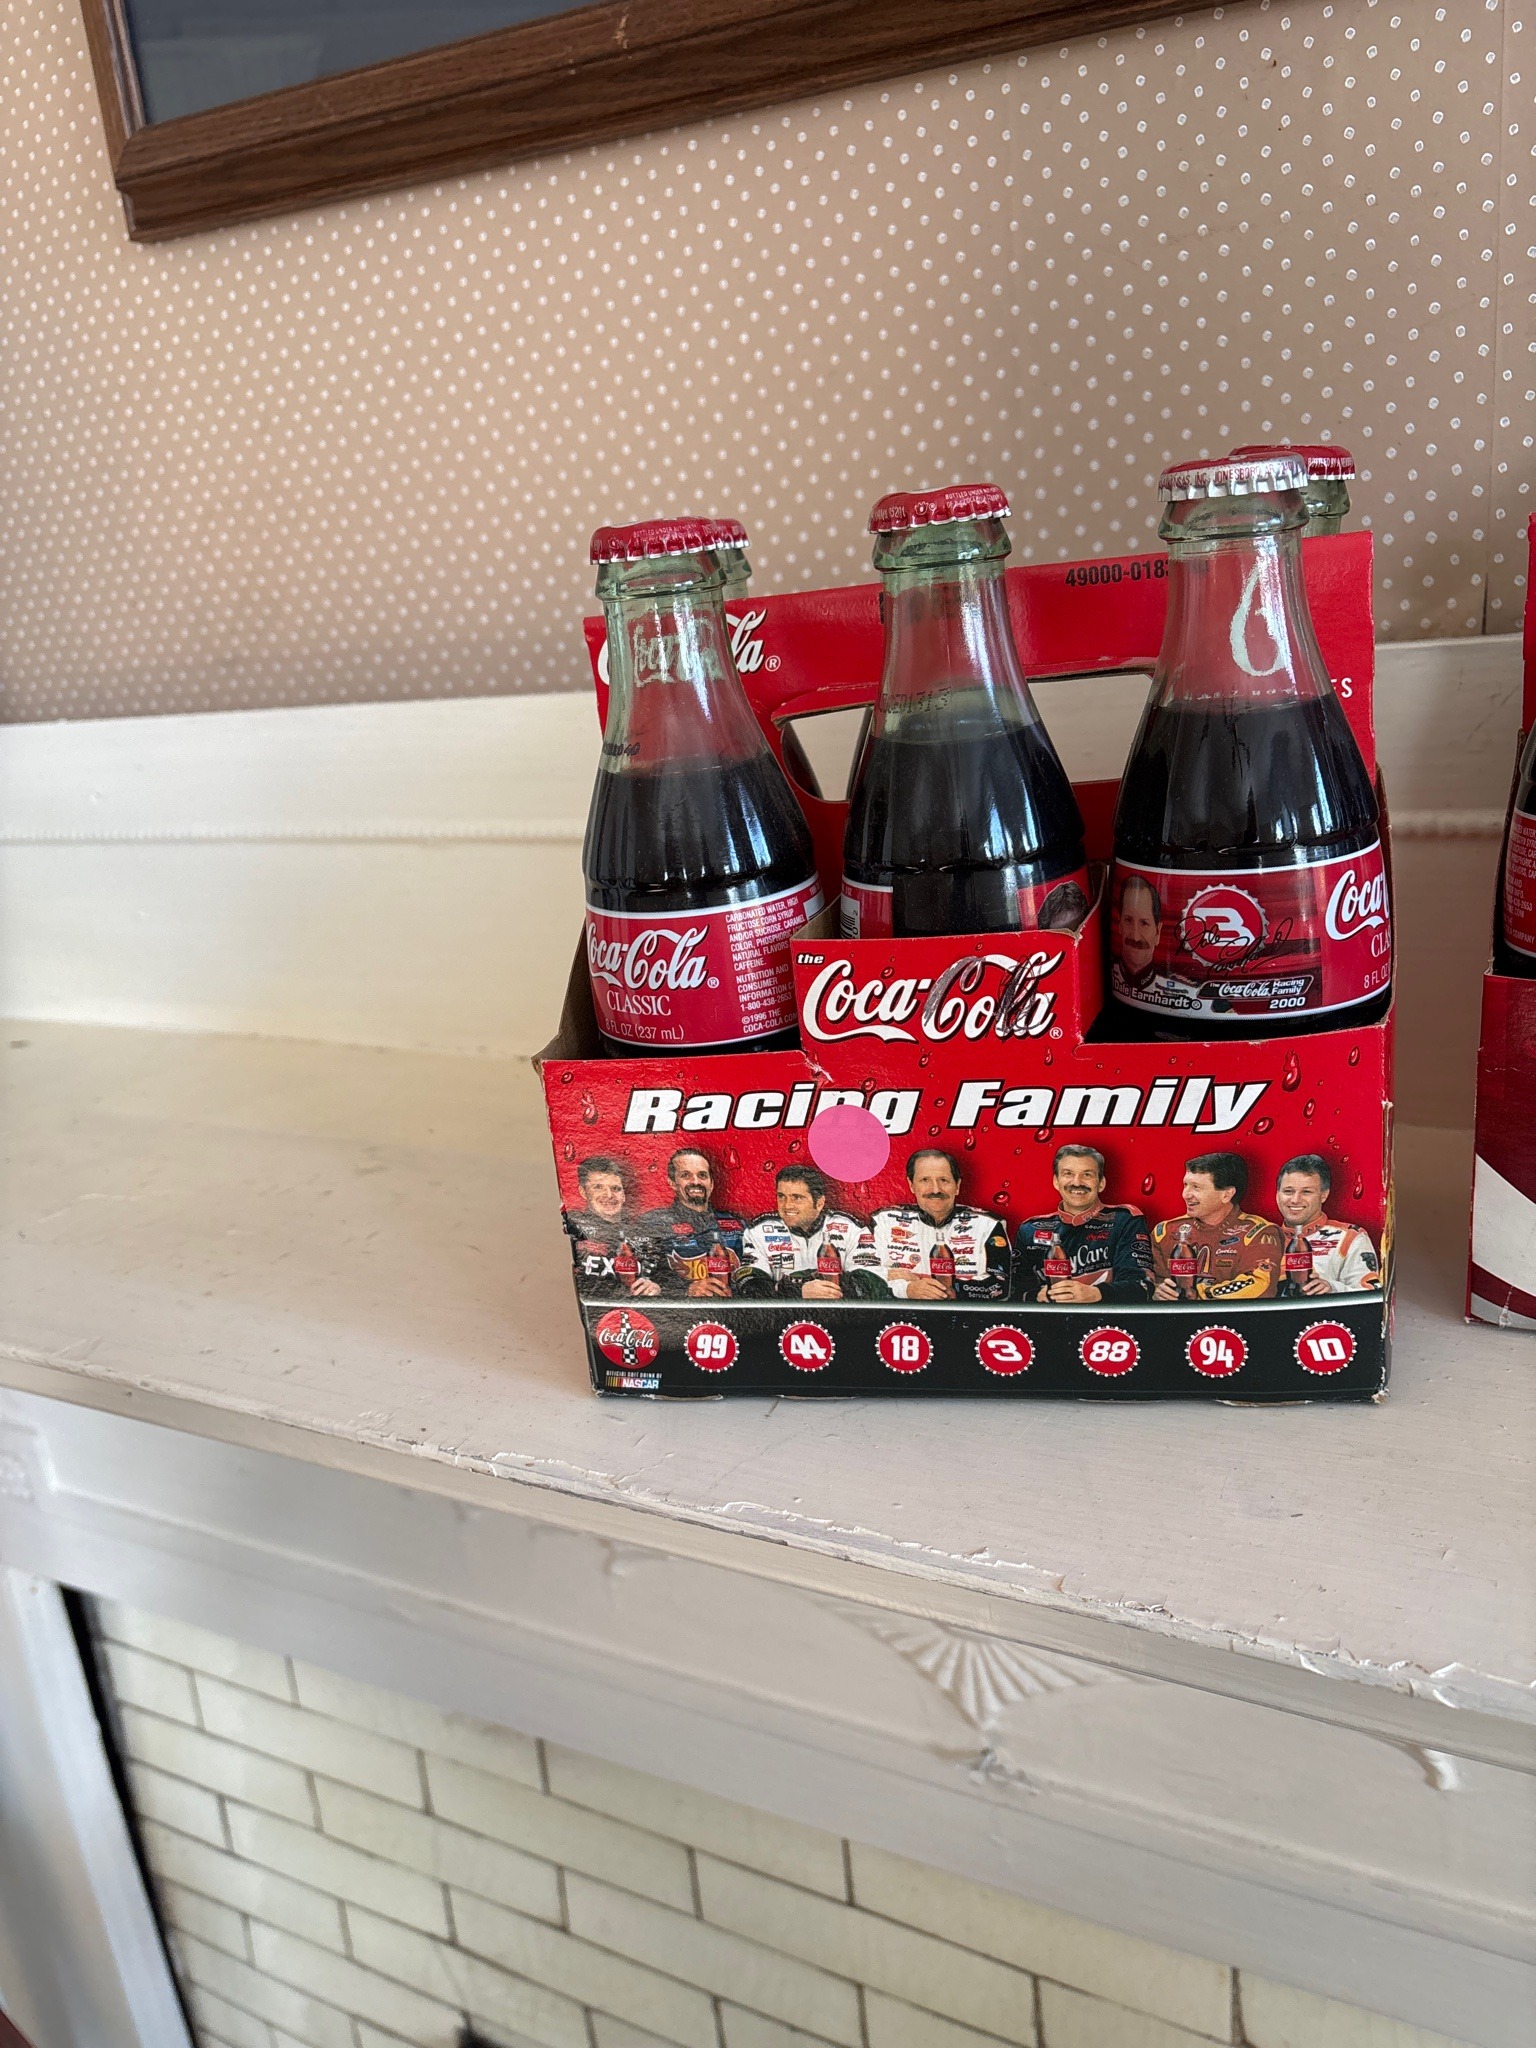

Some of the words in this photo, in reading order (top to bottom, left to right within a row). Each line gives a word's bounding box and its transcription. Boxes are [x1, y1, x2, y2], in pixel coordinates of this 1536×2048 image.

[725, 908, 766, 923] CARBONATED
[766, 901, 787, 916] WATER,
[787, 896, 799, 907] HIGH
[727, 919, 760, 933] FRUCTOSE
[761, 914, 777, 926] CORN
[777, 908, 794, 920] SYRUP
[729, 930, 754, 942] AND/OR
[783, 914, 806, 929] CARAMEL
[730, 941, 755, 952] COLOR,
[756, 931, 793, 947] PHOSPHORIC
[586, 923, 709, 990] Coca-Cola
[732, 949, 762, 962] NATURAL
[734, 958, 767, 971] CAFFEINE.
[797, 953, 824, 964] the
[736, 967, 774, 984] NUTRITION
[775, 964, 789, 974] AND
[1272, 978, 1305, 988] Racing
[1363, 974, 1370, 989] 8
[1371, 969, 1380, 986] FL
[738, 977, 778, 993] CONSUMER
[739, 984, 788, 1002] INFORMATION
[1218, 981, 1271, 997] Coca-Cola
[1271, 985, 1302, 996] Family
[606, 989, 672, 1016] CLASSIC
[740, 992, 792, 1012] 1-800-438-2653
[802, 950, 1064, 1043] Coca-Cola
[1131, 987, 1190, 1008] Earnhardt
[1269, 997, 1306, 1010] 2000
[768, 1008, 781, 1018] THE
[610, 1019, 620, 1034] FL
[620, 1023, 634, 1037] OZ
[635, 1023, 657, 1039] (237
[661, 1025, 684, 1040] mL)
[743, 1017, 783, 1033] COCA-COLA
[949, 1076, 1268, 1133] Family
[599, 1328, 654, 1348] Coca-Cola
[695, 1334, 728, 1359] 99
[790, 1334, 827, 1360] 44
[890, 1335, 919, 1361] 18
[986, 1340, 1023, 1362] 3
[1089, 1341, 1131, 1362] 88
[1199, 1336, 1234, 1368] 94
[1306, 1337, 1346, 1362] 10
[622, 1378, 659, 1389] NASCAR
